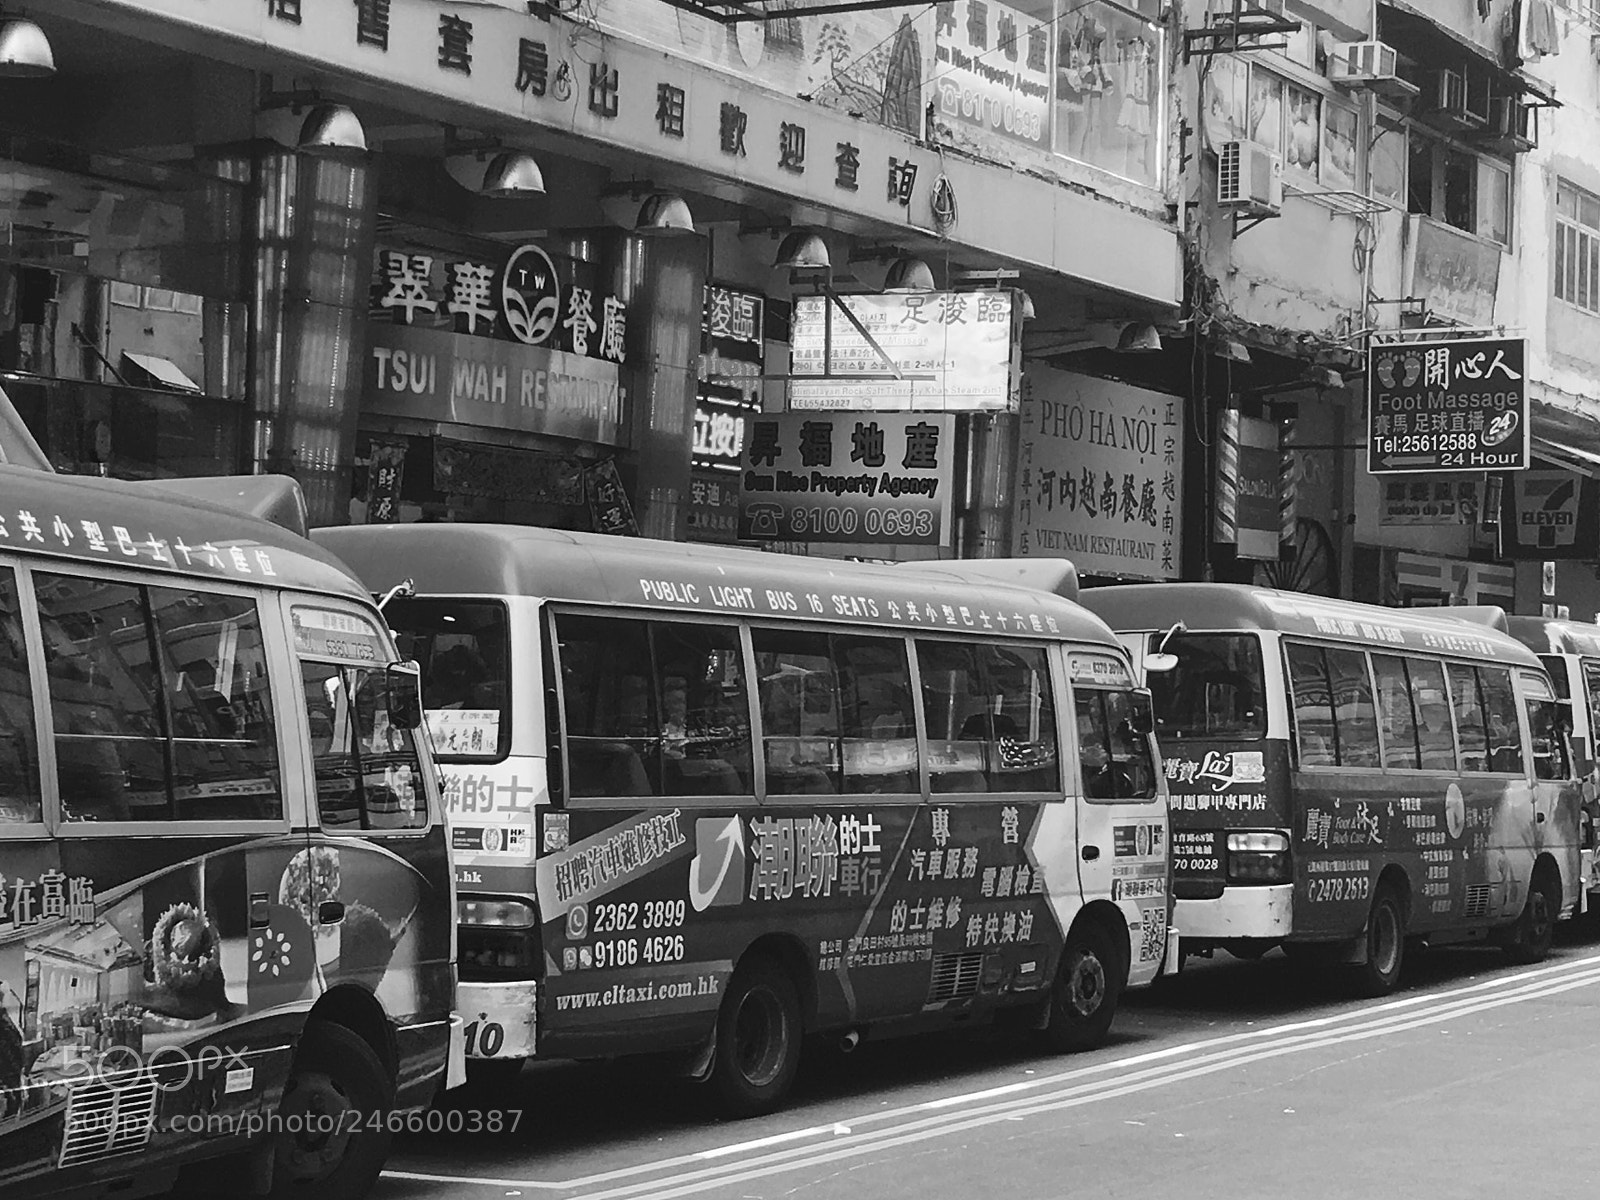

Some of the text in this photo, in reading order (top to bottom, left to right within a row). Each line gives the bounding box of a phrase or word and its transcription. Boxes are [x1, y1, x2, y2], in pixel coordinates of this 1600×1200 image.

[380, 251, 498, 334] 翠華
[373, 346, 437, 395] TSUI
[452, 359, 508, 404] WAH
[1424, 347, 1521, 390] 開心人
[1378, 391, 1519, 411] Foot Massage
[1374, 433, 1476, 452] Tel:25612588
[1441, 452, 1518, 465] 24 Hour
[810, 472, 877, 497] Property
[878, 472, 938, 498] Agency
[1162, 403, 1177, 571] 正宗越南菜
[790, 507, 933, 536] 8100 0693
[1090, 535, 1156, 561] RESTAURANT
[639, 579, 880, 618] PUBLIC LIGHT BUS 16 SEATS
[839, 813, 882, 855] 的士
[839, 856, 882, 897] 車行
[1190, 859, 1219, 870] 0028
[594, 900, 685, 932] 2362 3899
[595, 935, 684, 968] 9186 4626
[556, 975, 719, 1010] www.cltaxi.com.hk
[465, 1021, 504, 1056] 10
